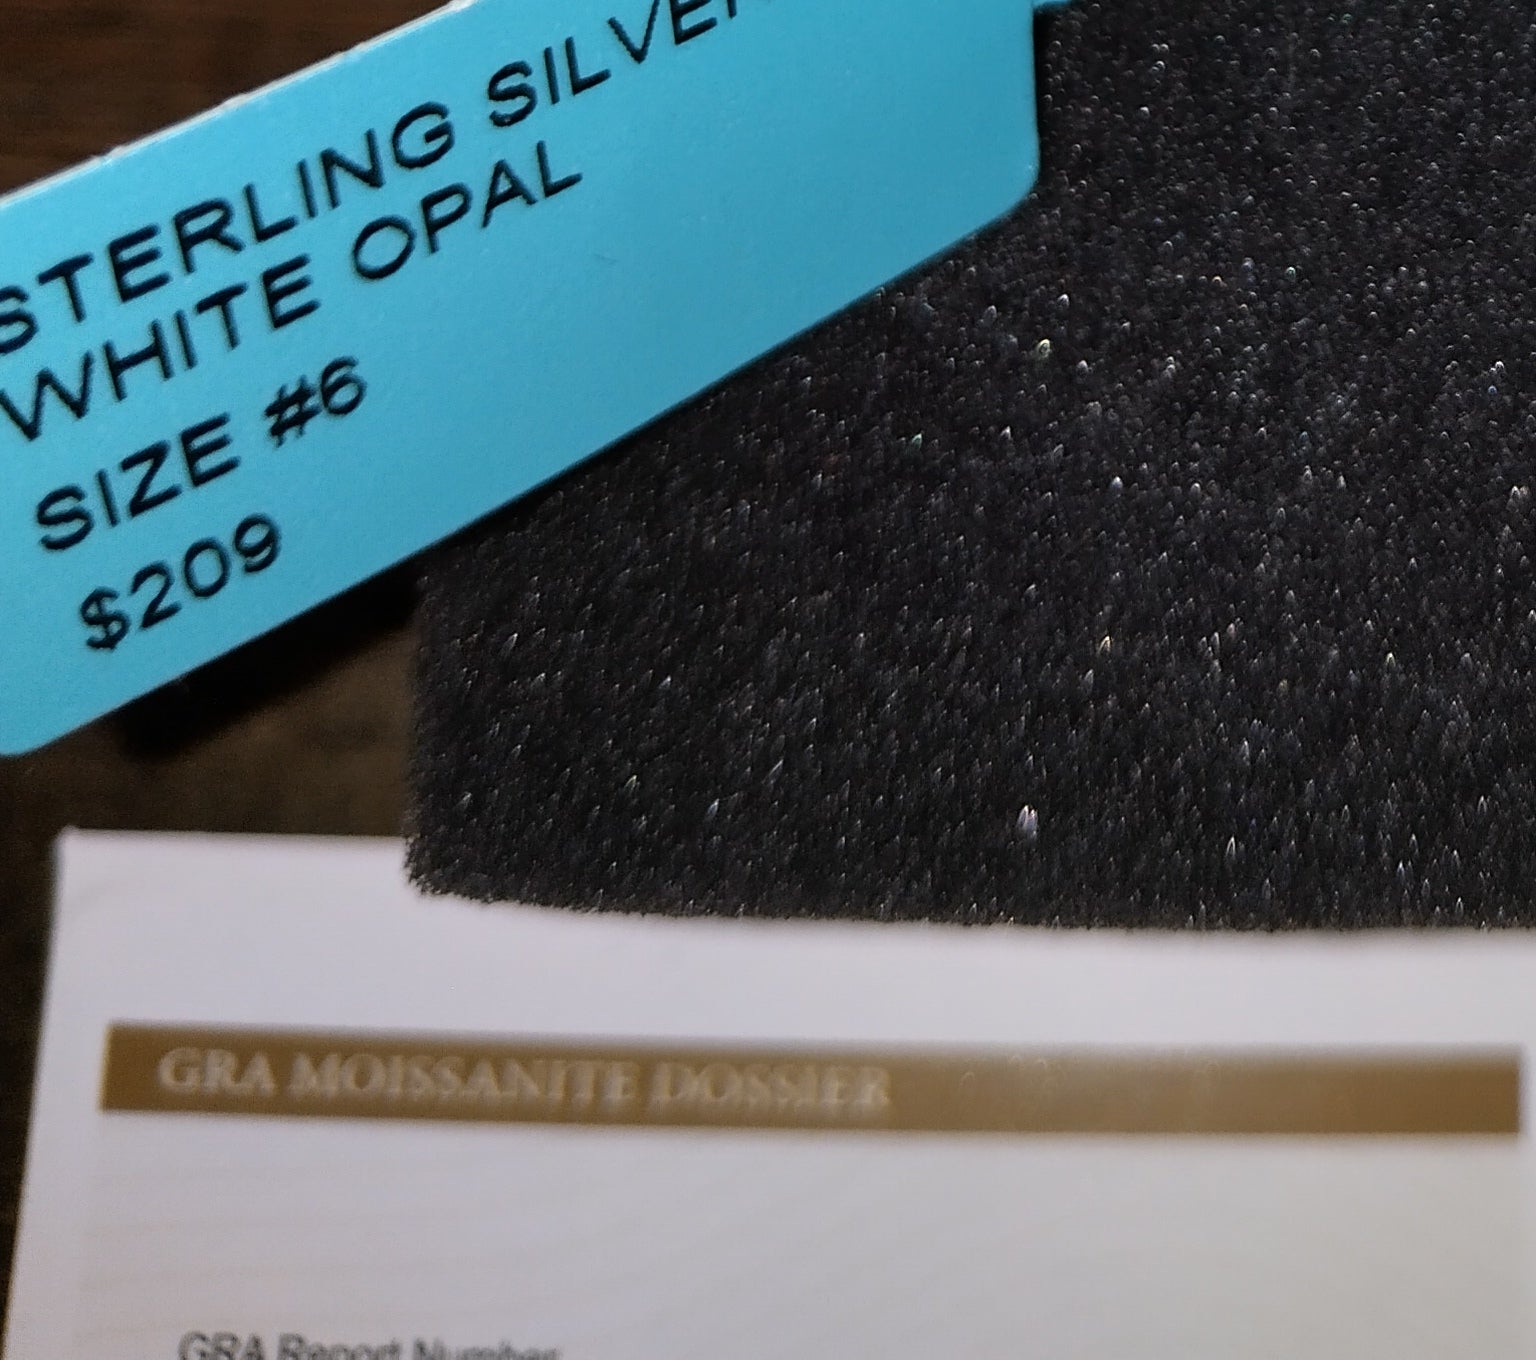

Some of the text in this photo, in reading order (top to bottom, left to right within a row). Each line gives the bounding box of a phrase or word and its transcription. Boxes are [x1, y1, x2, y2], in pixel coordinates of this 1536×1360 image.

[0, 102, 457, 356] STERLING
[0, 140, 584, 442] WHITE OPAL
[35, 355, 368, 553] SIZE #6
[78, 512, 283, 652] $209
[157, 1046, 893, 1114] GRA MOISSANITE DOSSIER
